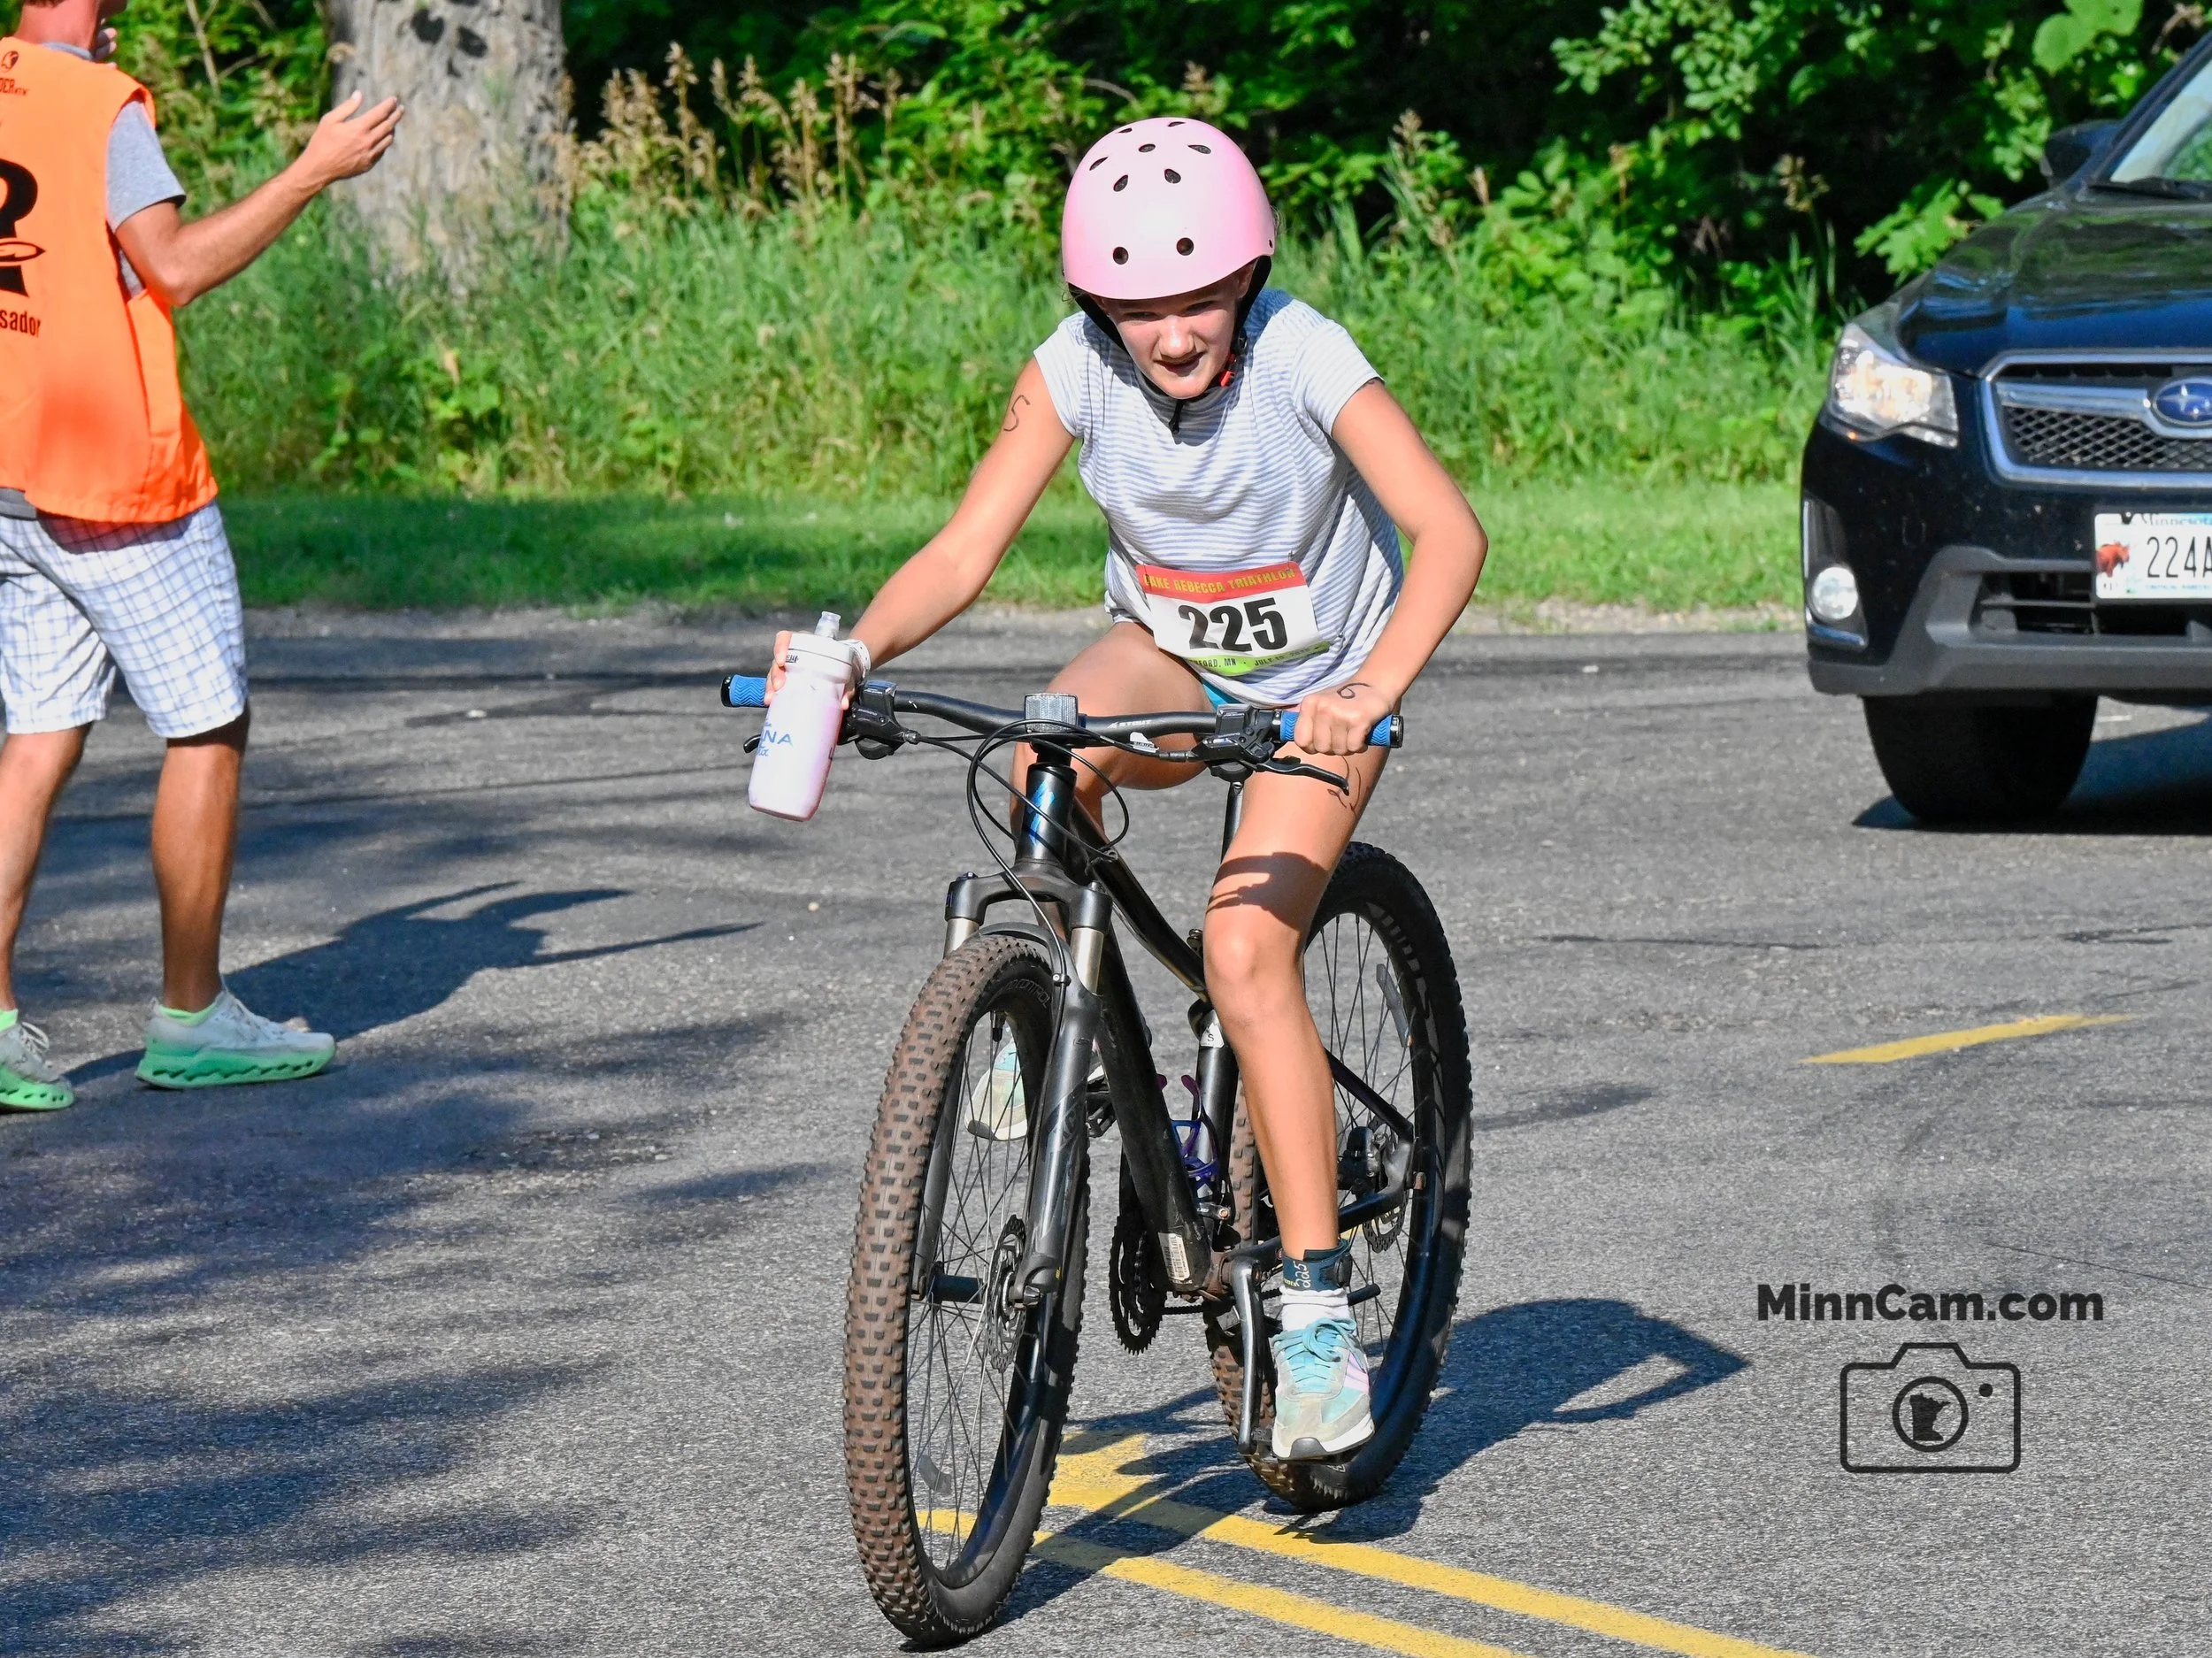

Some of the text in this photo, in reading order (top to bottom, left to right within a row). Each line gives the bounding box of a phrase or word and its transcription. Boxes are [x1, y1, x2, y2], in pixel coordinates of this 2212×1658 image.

[1143, 567, 1296, 595] LAKE REBECCA TRIATHLON
[1178, 596, 1288, 652] 225
[761, 729, 794, 747] NA
[1293, 1260, 1311, 1288] 225
